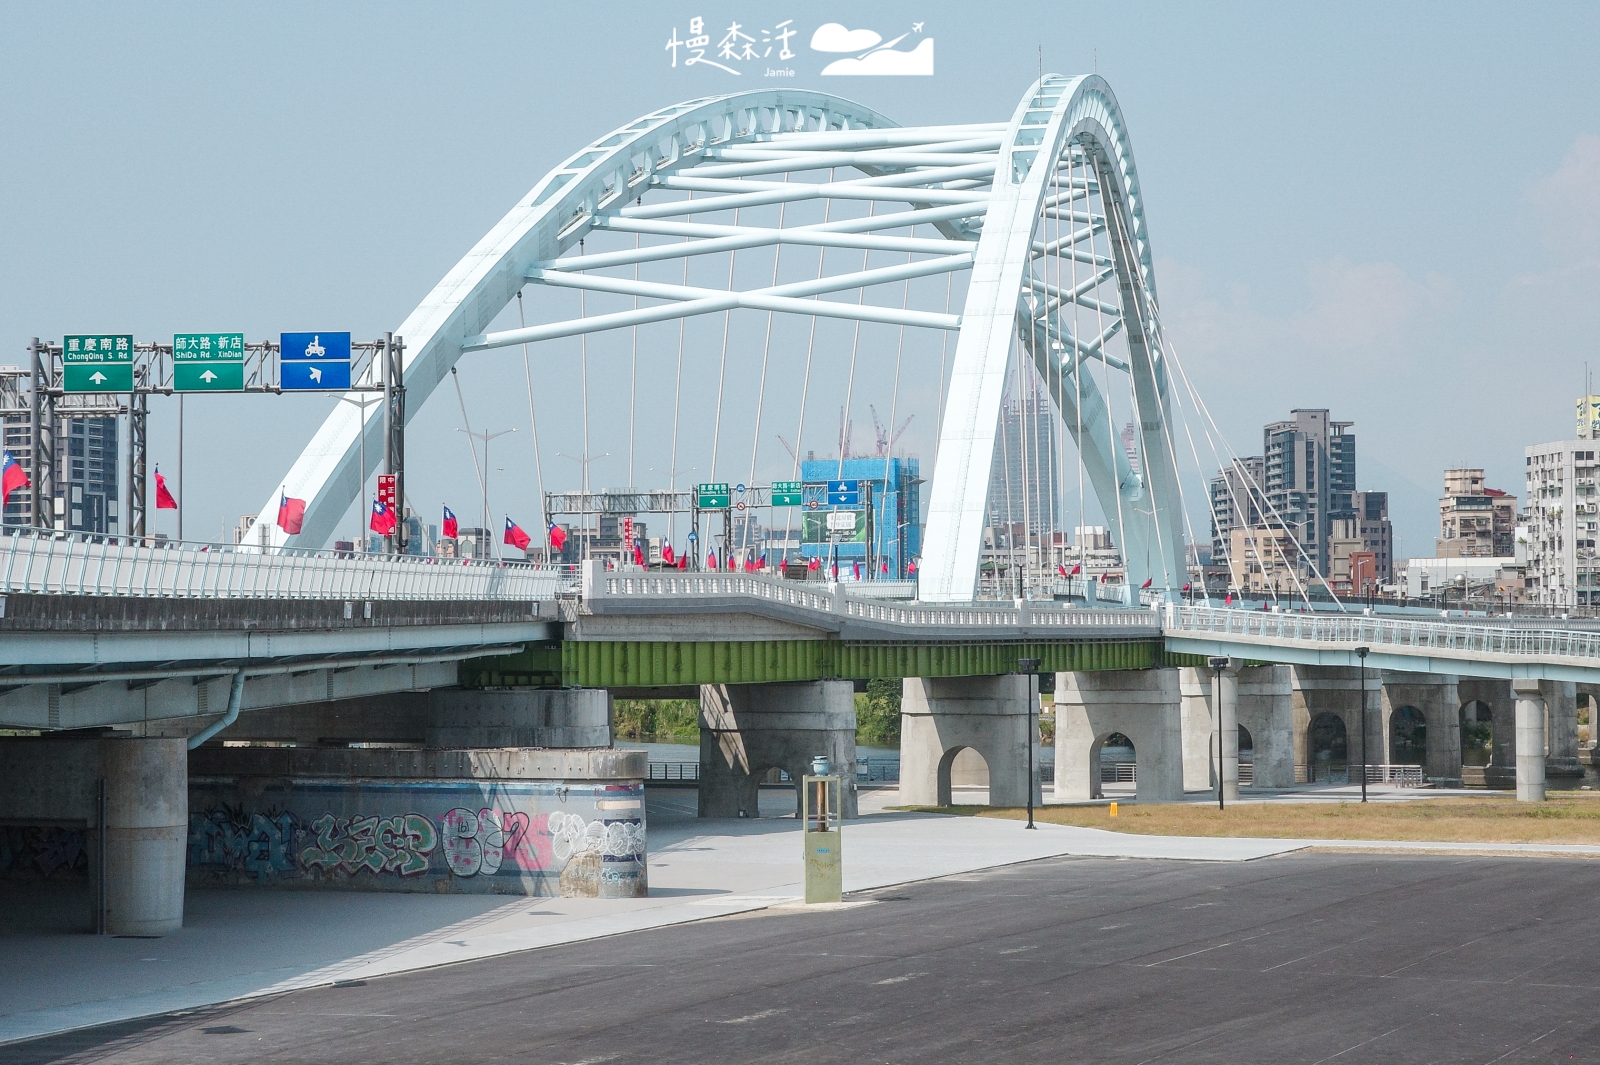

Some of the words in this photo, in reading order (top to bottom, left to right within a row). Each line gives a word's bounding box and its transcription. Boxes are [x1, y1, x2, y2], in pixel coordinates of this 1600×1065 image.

[68, 337, 129, 351] 重慶南路
[175, 336, 242, 350] 師大路、新店
[67, 352, 104, 362] ChongQing
[118, 352, 130, 360] Rd.
[175, 351, 197, 359] ShiDa
[217, 350, 242, 358] XinDian
